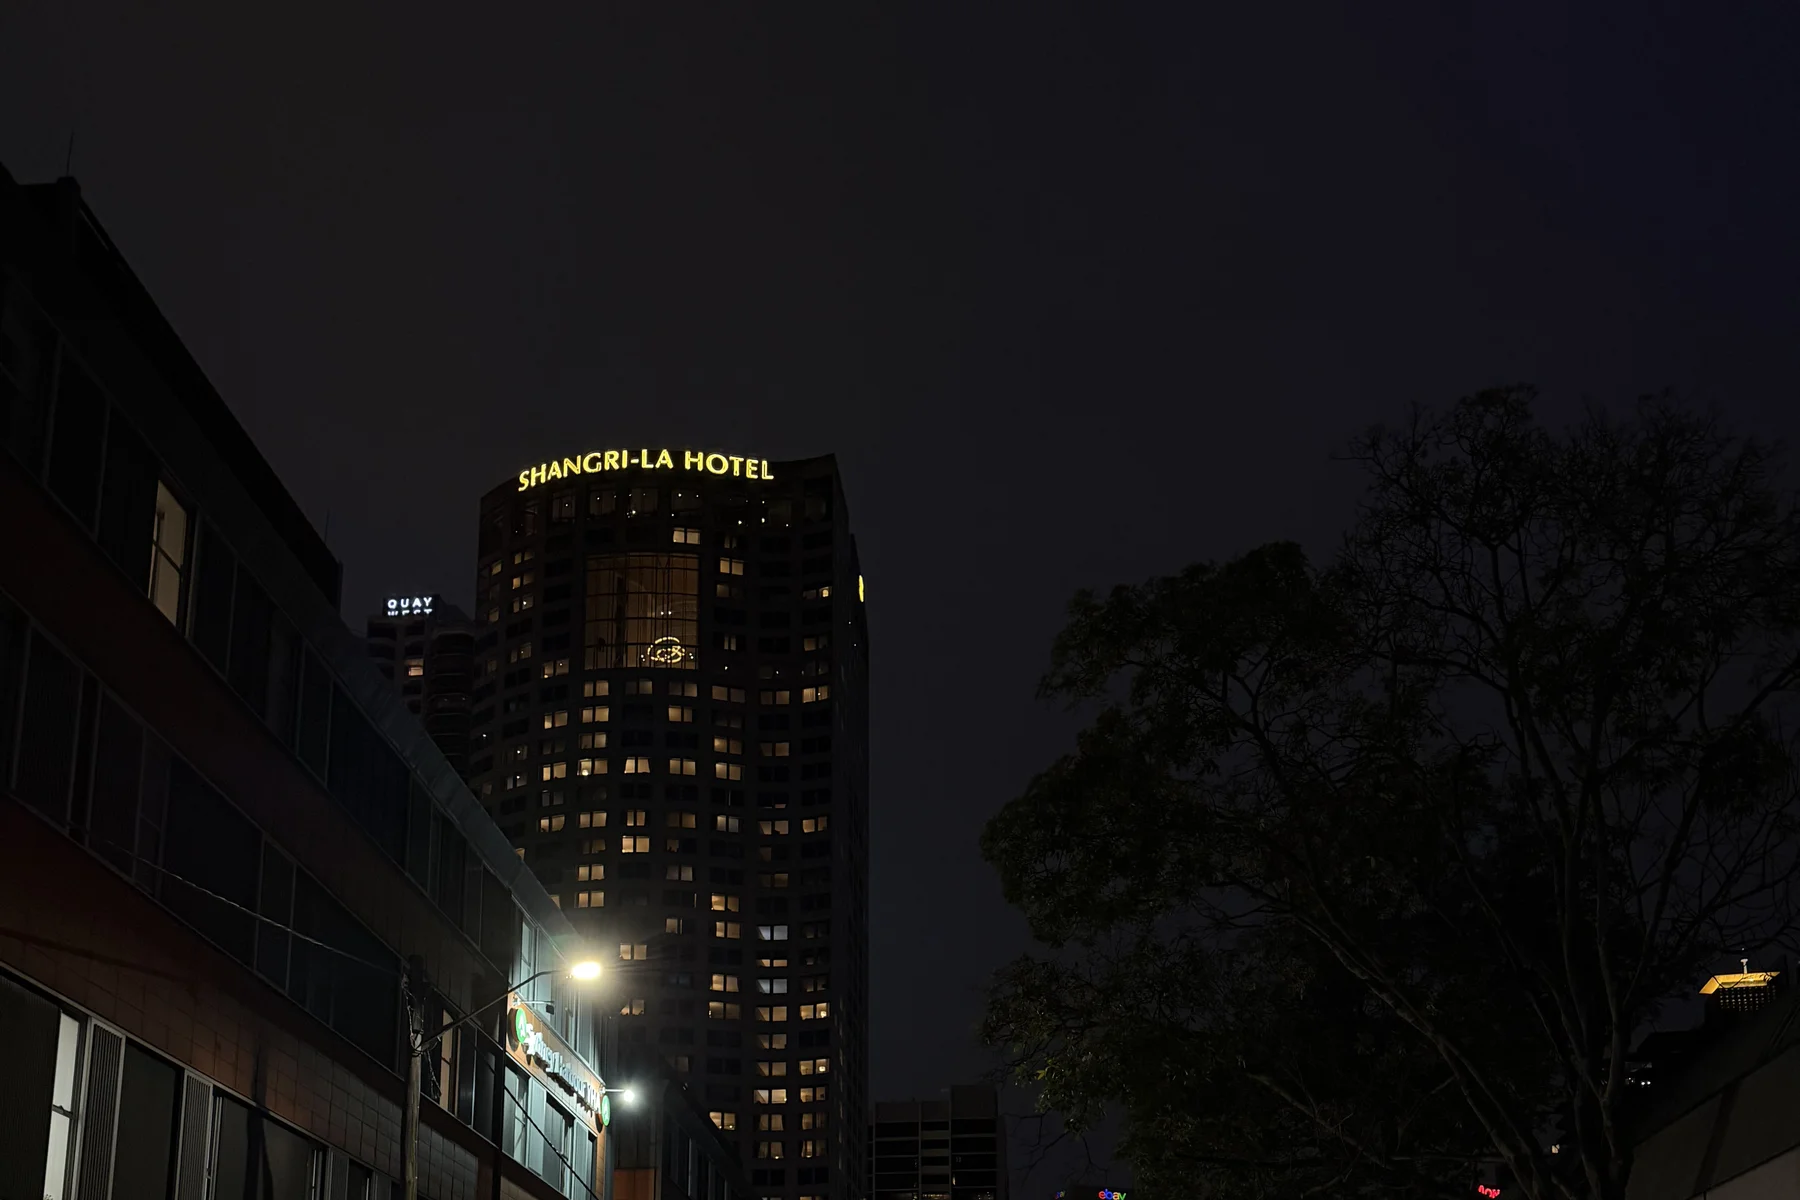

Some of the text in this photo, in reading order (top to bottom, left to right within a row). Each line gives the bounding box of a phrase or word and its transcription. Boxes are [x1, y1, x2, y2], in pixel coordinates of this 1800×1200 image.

[518, 449, 774, 492] SHANGRI-LA HOTEL
[387, 597, 433, 609] QUAY
